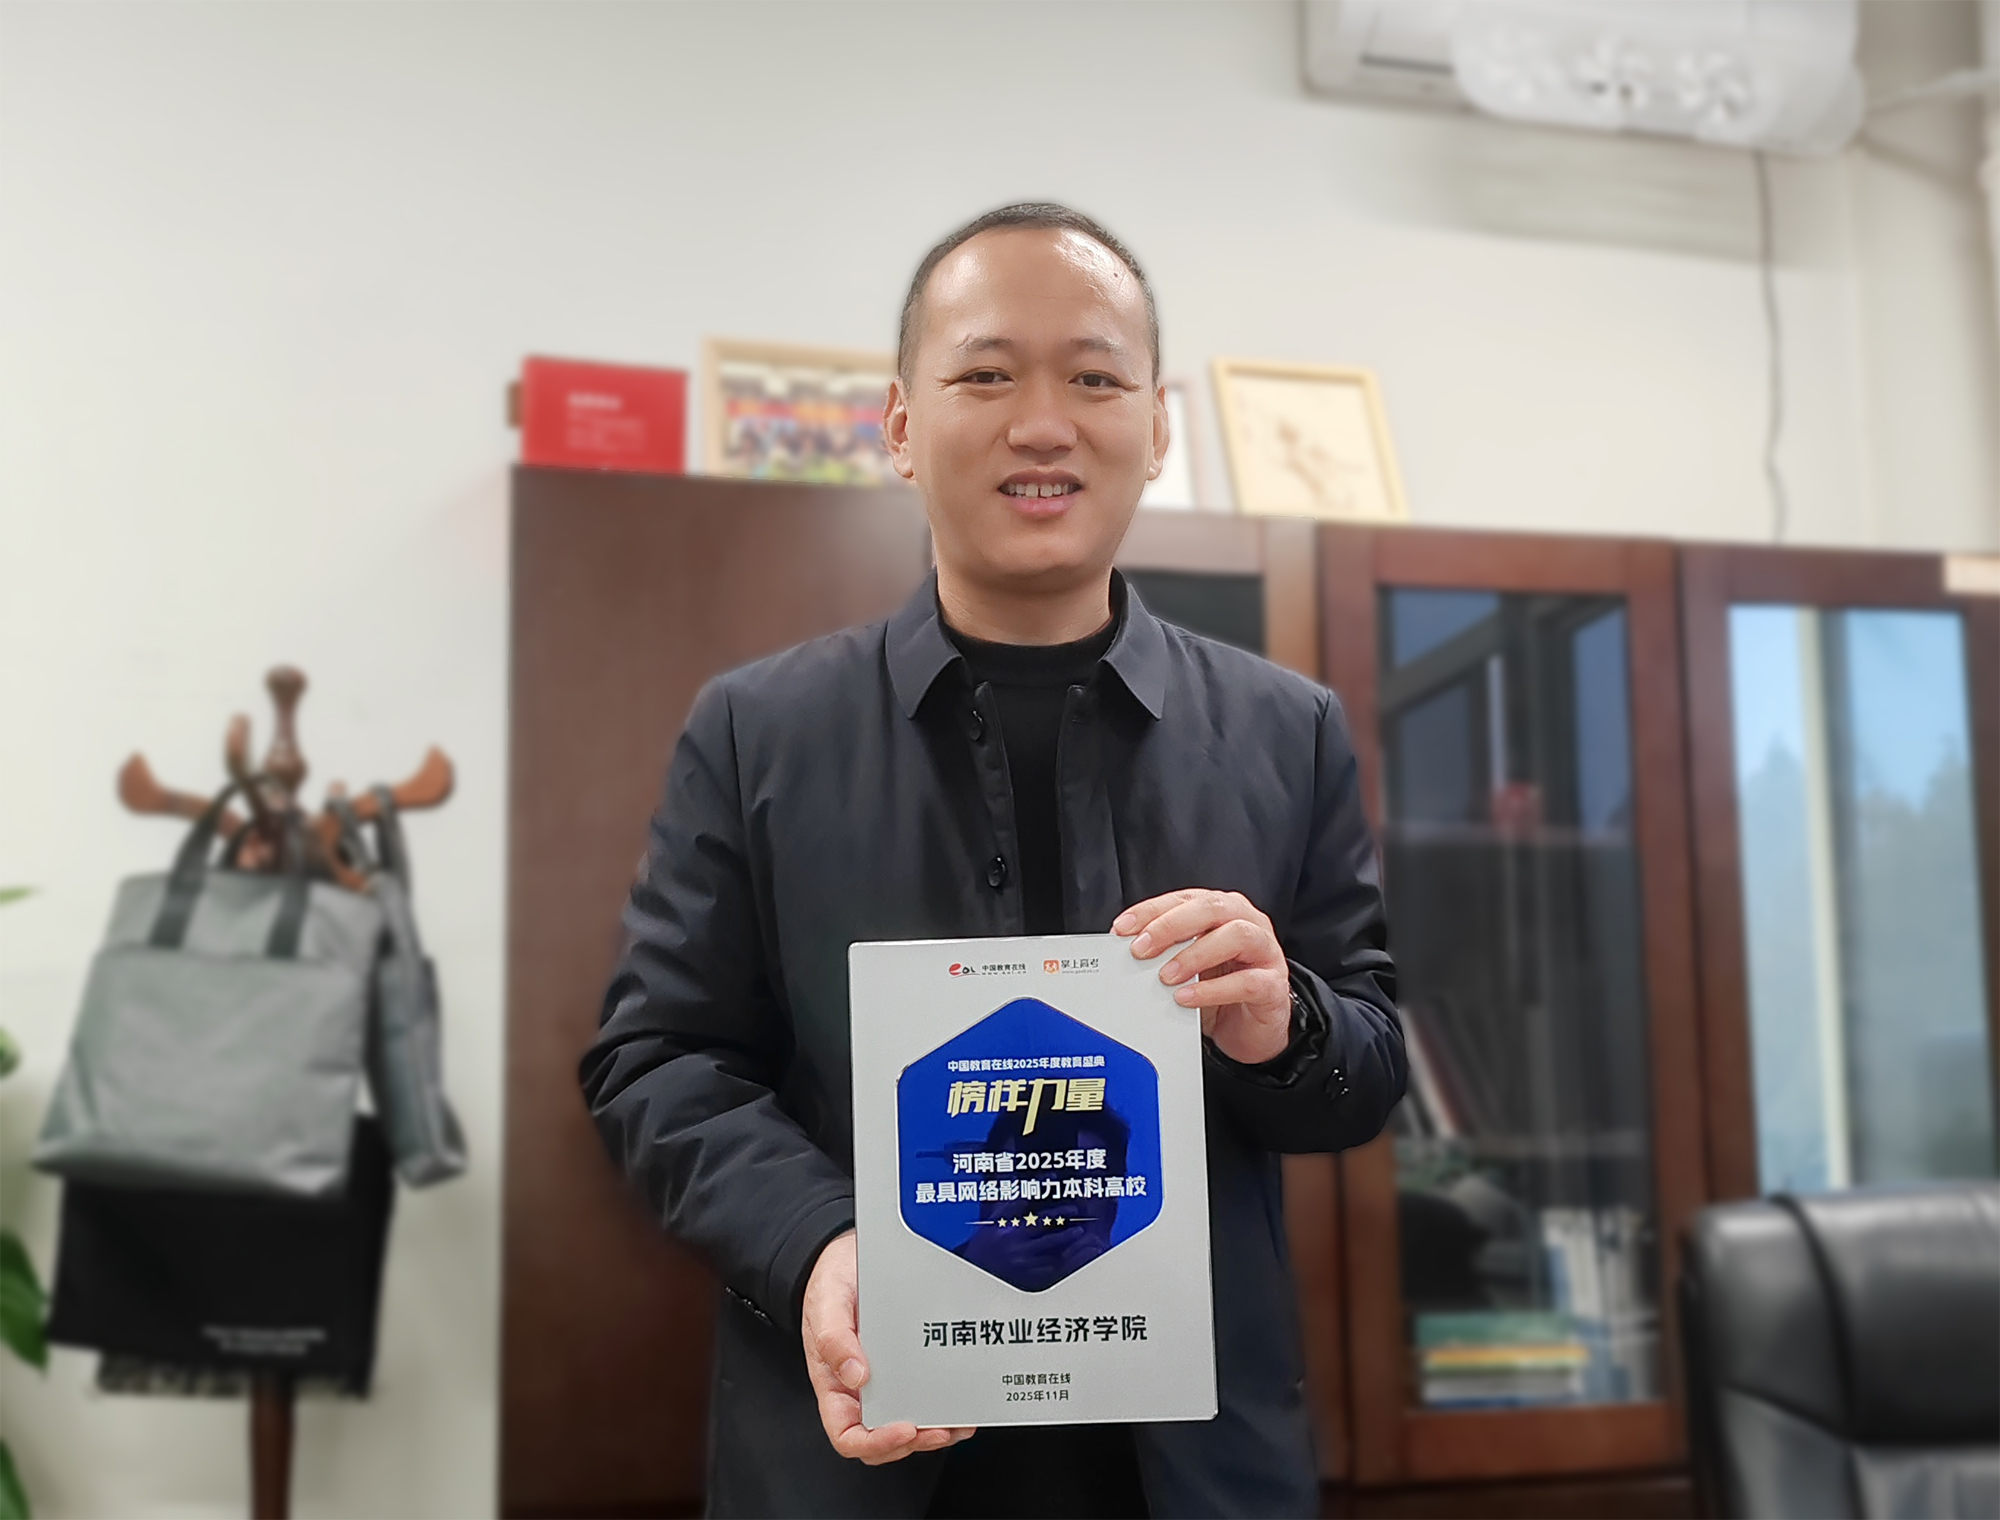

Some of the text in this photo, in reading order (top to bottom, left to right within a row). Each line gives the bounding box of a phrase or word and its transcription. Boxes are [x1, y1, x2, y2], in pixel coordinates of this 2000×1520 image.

[981, 963, 1027, 972] 中国教育在线
[1060, 958, 1100, 969] 掌上高考
[947, 1055, 1106, 1073] 中国教育在线2025年度教育盛典
[947, 1078, 1106, 1136] 榜样力量
[952, 1148, 1107, 1175] 河南省2025年度
[915, 1175, 1147, 1204] 最具网络影响力本科高校
[922, 1314, 1149, 1348] 河南牧业经济学院
[1001, 1372, 1072, 1386] 中国教育在线
[1005, 1389, 1070, 1402] 2025年11月
